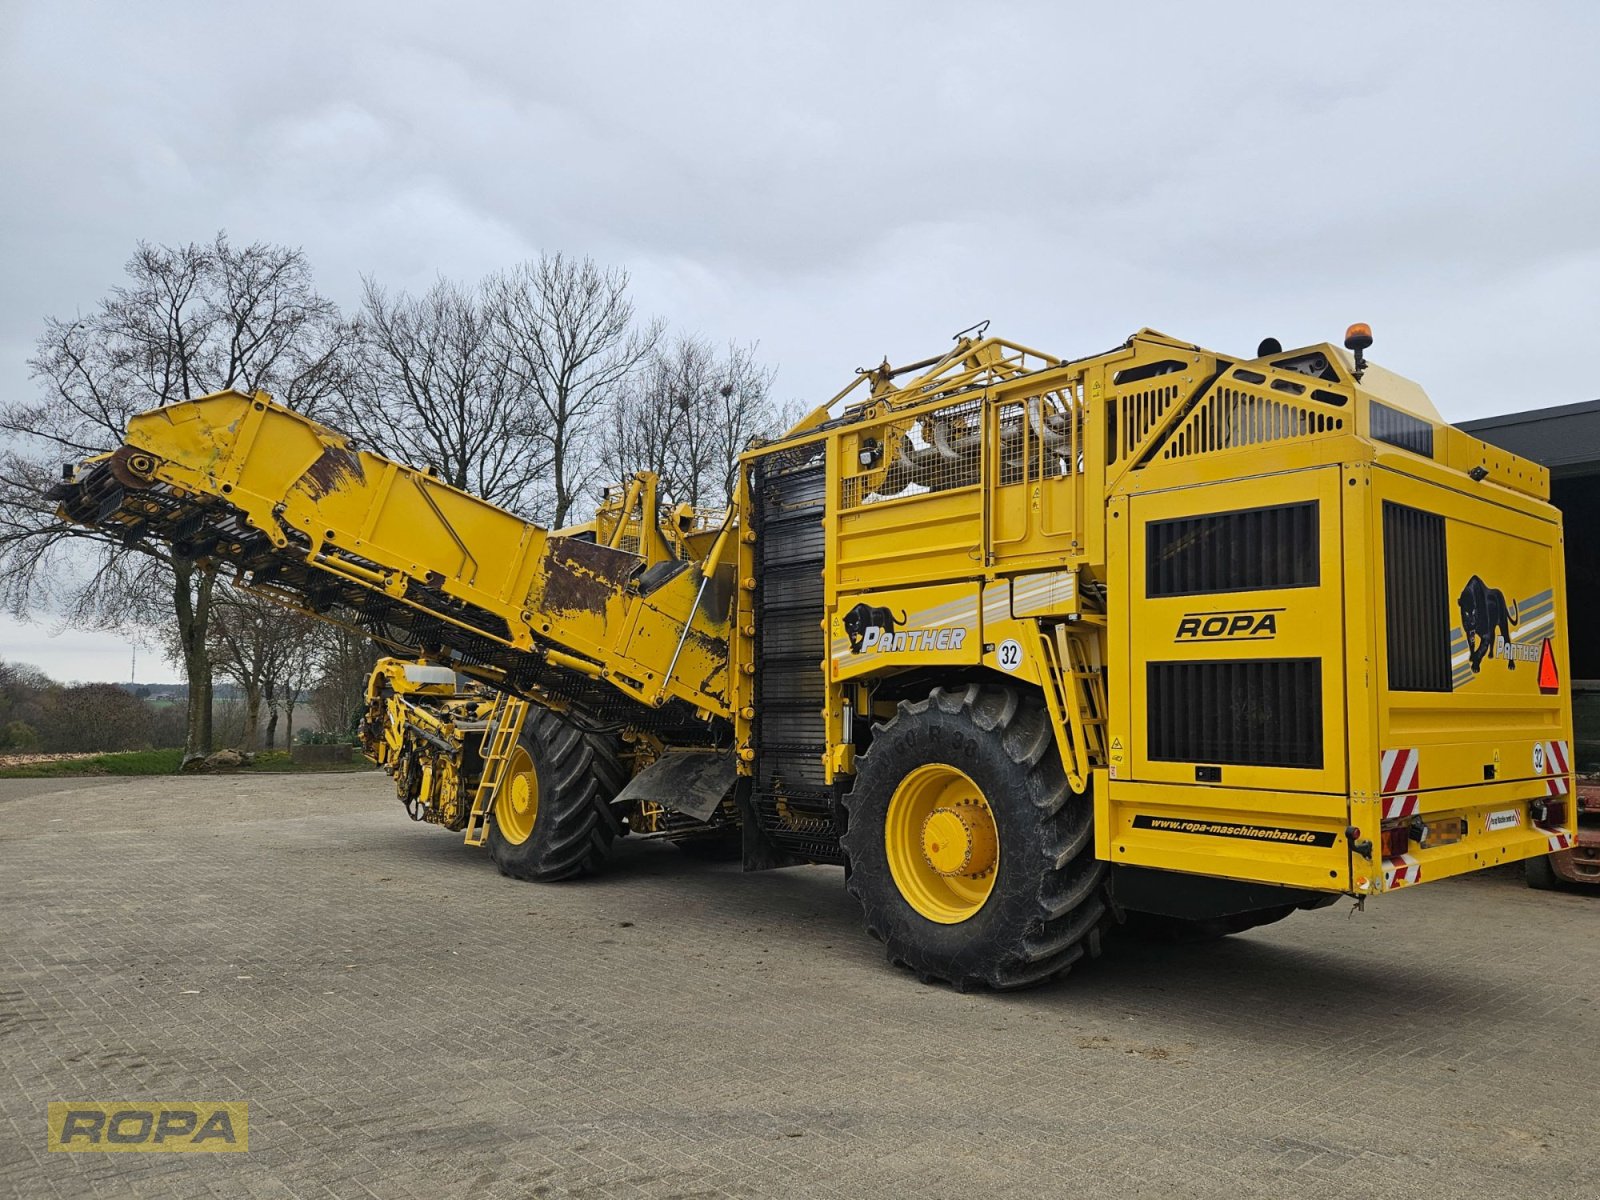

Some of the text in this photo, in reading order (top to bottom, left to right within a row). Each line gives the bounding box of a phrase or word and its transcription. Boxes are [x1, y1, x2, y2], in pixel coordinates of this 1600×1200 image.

[1175, 614, 1277, 638] ROPA
[861, 626, 966, 653] PANTHER
[1002, 645, 1018, 665] 32
[1534, 748, 1543, 769] 32
[1151, 818, 1316, 843] www.ropa-maschinenbau.de
